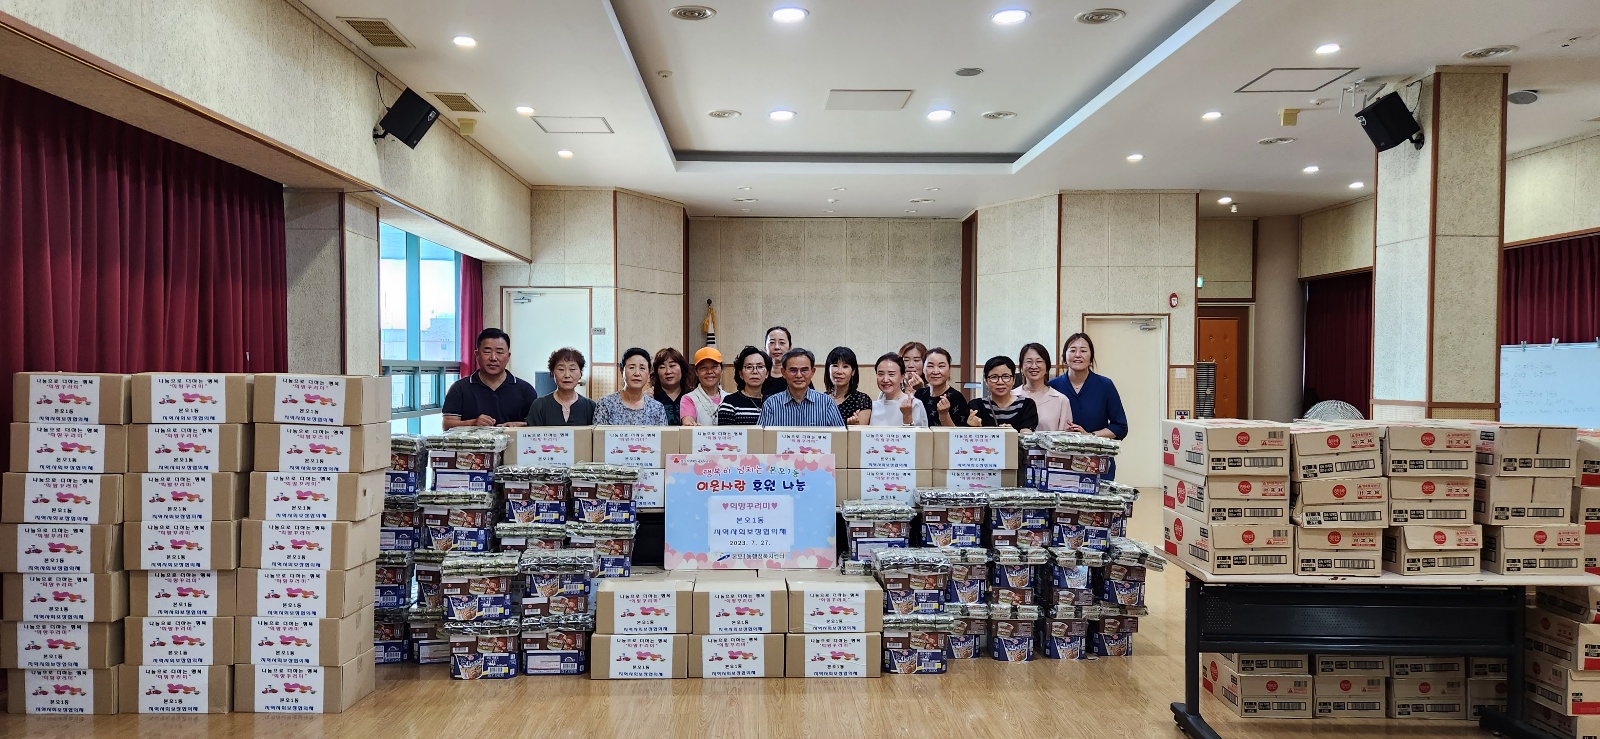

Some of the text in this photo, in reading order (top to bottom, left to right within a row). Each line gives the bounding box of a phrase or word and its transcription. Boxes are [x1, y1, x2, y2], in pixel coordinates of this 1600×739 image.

[696, 478, 806, 492] 이웃사랑 후원 나눔
[729, 502, 771, 510] 희망꾸러미
[713, 528, 787, 536] 지역사회보장협의체
